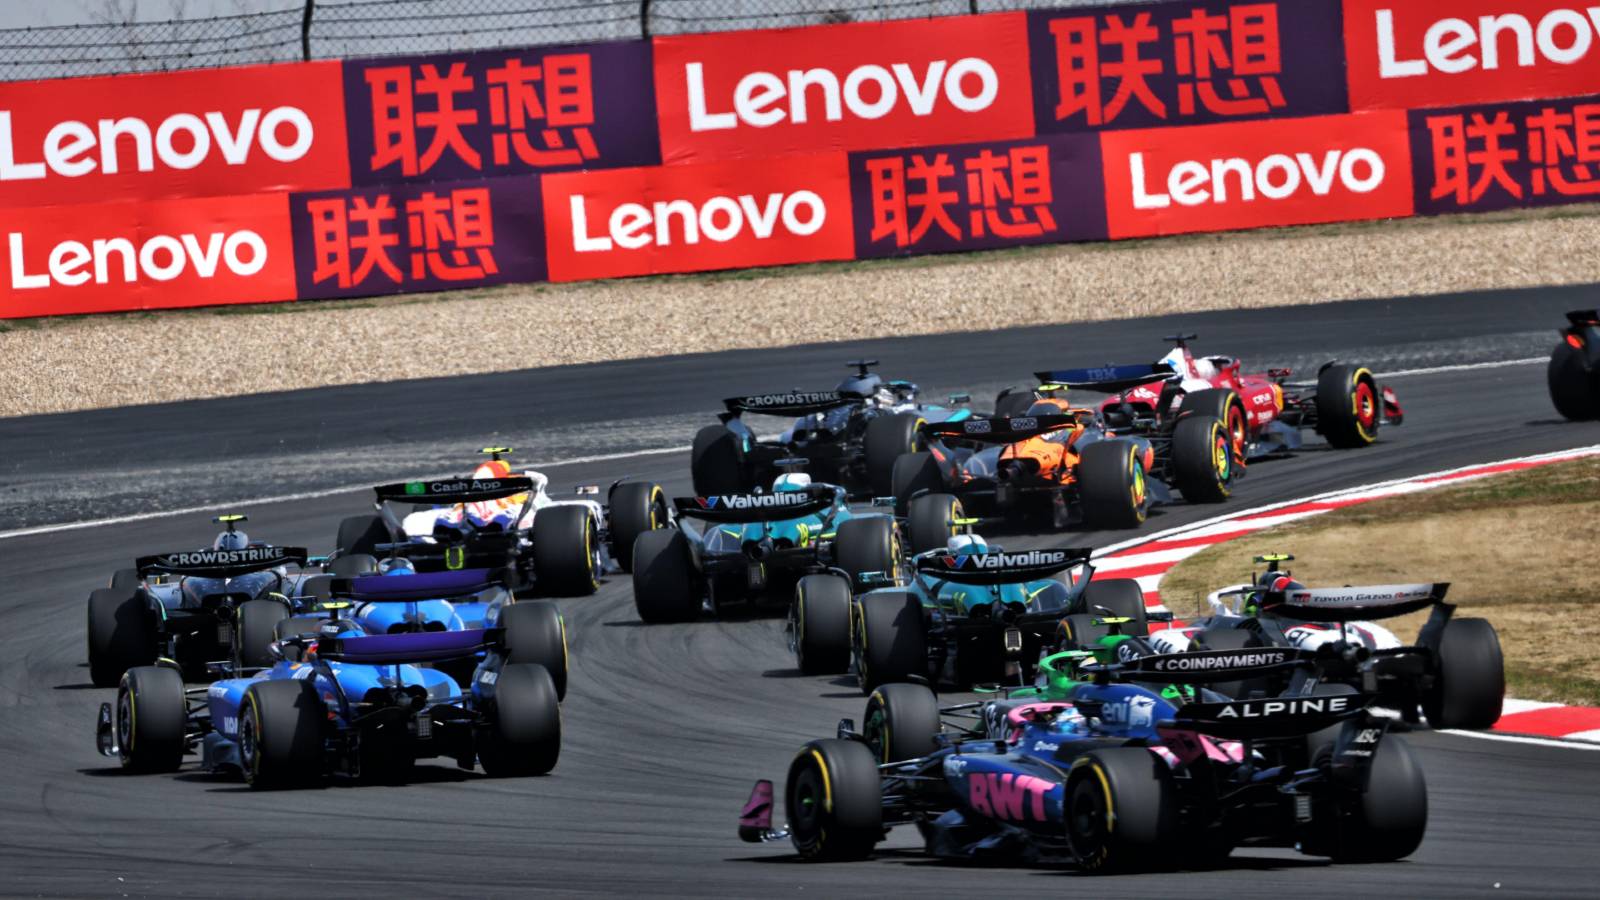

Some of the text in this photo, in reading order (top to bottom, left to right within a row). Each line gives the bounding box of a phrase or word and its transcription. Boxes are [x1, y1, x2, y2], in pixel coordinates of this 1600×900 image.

[1049, 3, 1287, 126] 联想
[1376, 7, 1600, 78] Leno
[365, 54, 599, 178] 联想
[686, 58, 998, 131] Lenovo
[0, 107, 313, 180] Lenovo
[1427, 103, 1600, 205] 联想
[867, 145, 1056, 246] 联想
[1130, 148, 1385, 209] Lenovo
[308, 188, 498, 288] 联想
[570, 190, 826, 251] Lenovo
[9, 230, 267, 288] Lenovo
[746, 391, 840, 407] CROWDSTRIKE
[1087, 368, 1116, 381] IBM
[431, 481, 469, 492] Cash
[471, 480, 501, 491] App
[722, 492, 808, 509] Valvoline
[168, 547, 285, 565] CROWDSTRIKE
[971, 551, 1065, 569] Valvoline
[1166, 652, 1285, 671] COINPAYMENTS
[1102, 695, 1131, 722] eni
[1217, 698, 1348, 718] ALPINE
[968, 772, 1057, 822] BWT
